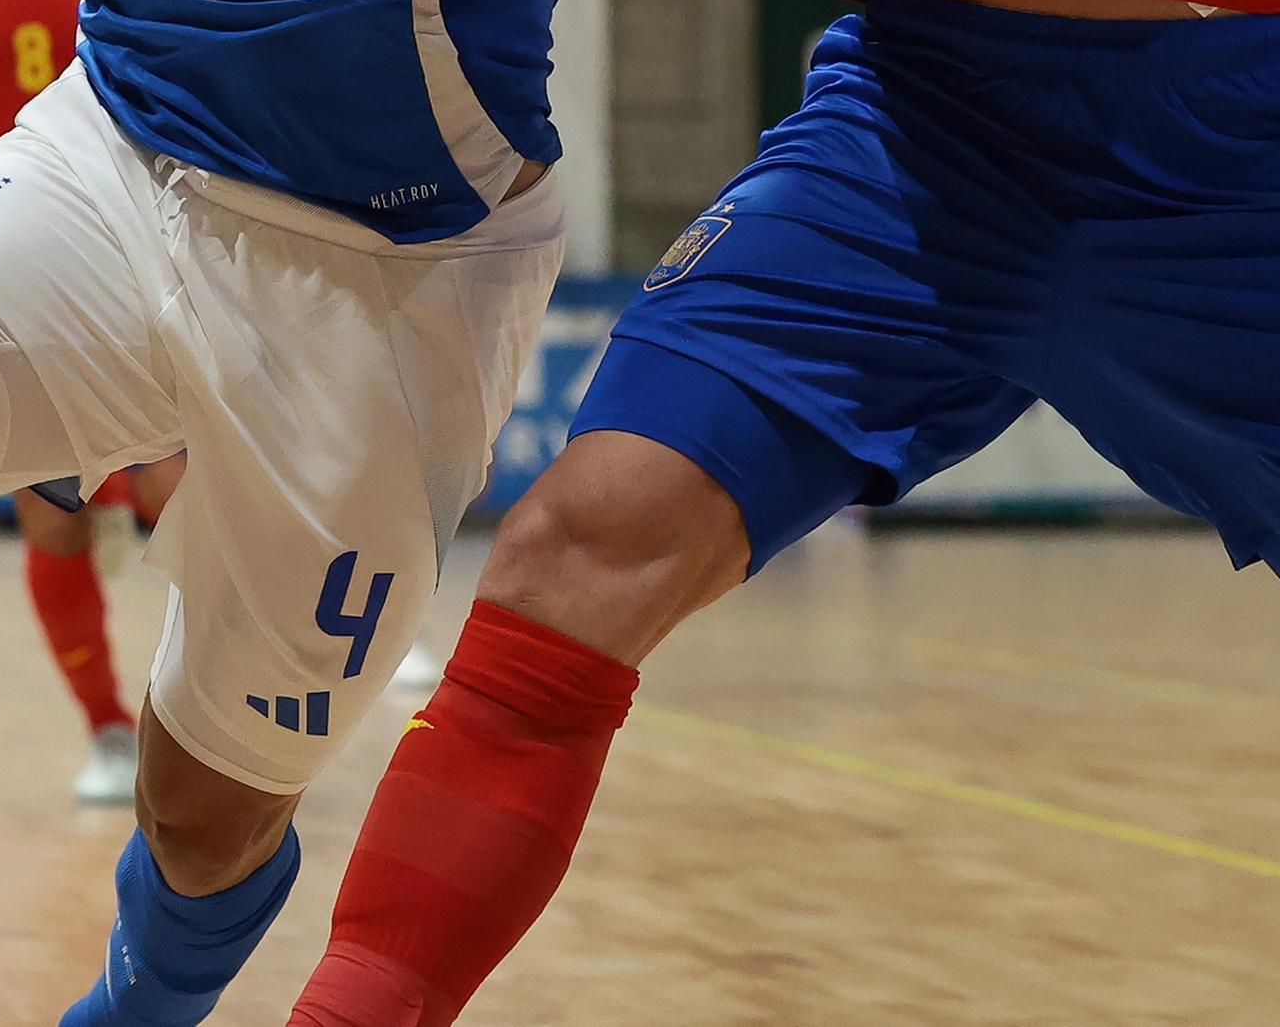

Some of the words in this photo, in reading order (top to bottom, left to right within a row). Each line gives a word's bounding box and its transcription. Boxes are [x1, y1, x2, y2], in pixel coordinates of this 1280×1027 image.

[13, 21, 56, 94] 8
[370, 182, 439, 210] HEAT.RDY
[315, 550, 396, 680] 4
